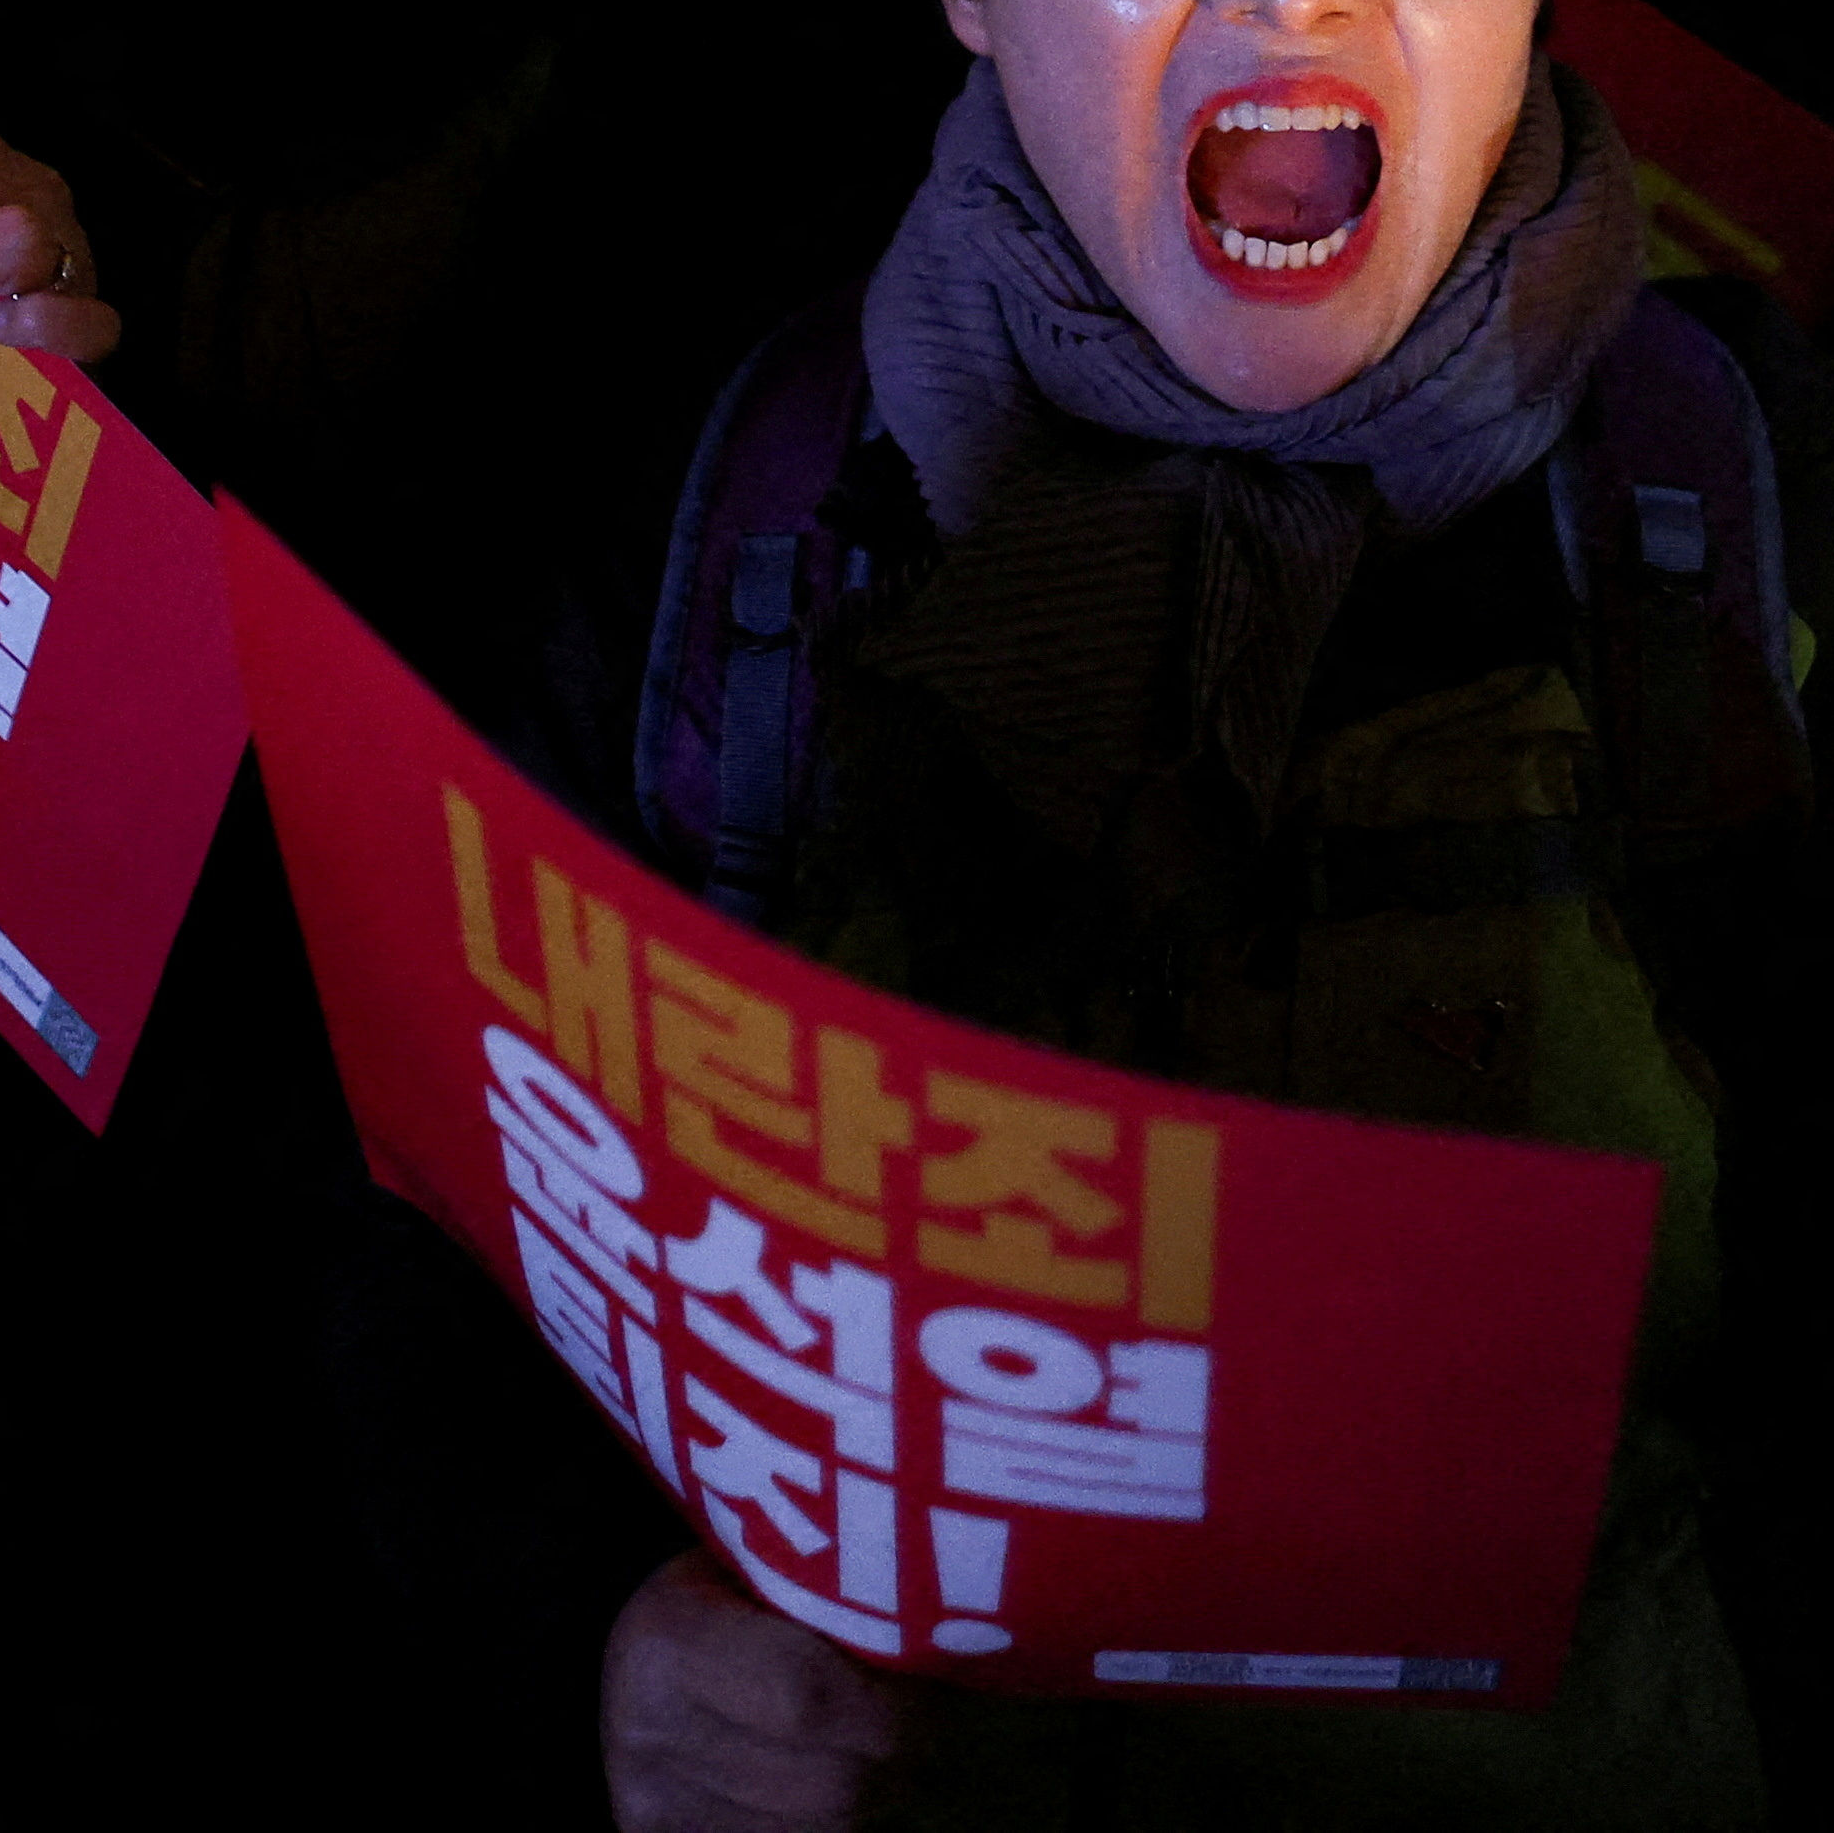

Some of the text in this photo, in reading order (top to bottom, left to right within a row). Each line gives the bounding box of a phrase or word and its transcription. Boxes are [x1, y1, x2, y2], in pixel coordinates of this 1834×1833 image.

[441, 780, 1223, 1334] 내란죄
[482, 1024, 1212, 1523] 윤석열
[509, 1204, 1015, 1657] 퇴진!
